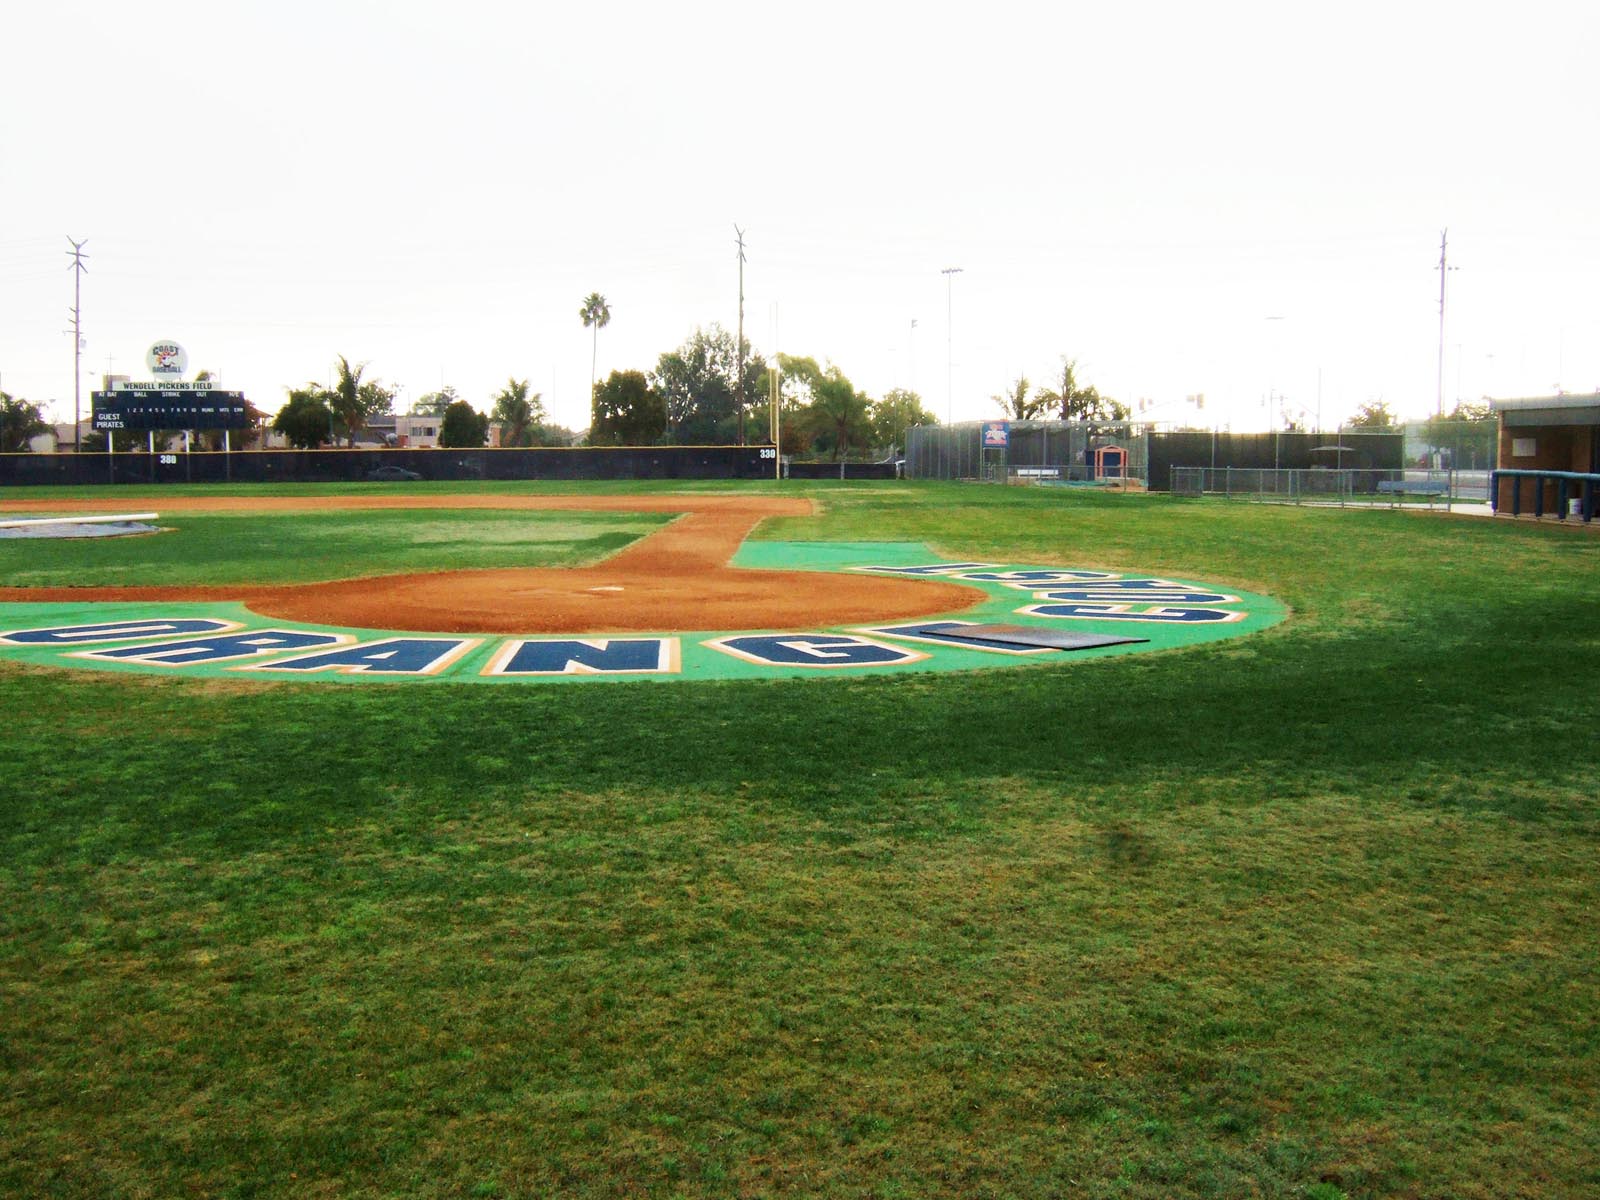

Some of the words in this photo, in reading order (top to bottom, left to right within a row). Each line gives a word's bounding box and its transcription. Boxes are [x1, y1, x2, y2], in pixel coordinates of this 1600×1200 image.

[153, 345, 179, 356] COAST
[123, 382, 155, 390] WENDELL
[158, 382, 190, 390] PICKENS
[193, 382, 212, 390] FIELD
[98, 413, 120, 421] GUEST
[96, 421, 125, 429] PIRATES
[760, 449, 776, 459] 330
[160, 455, 177, 464] 380
